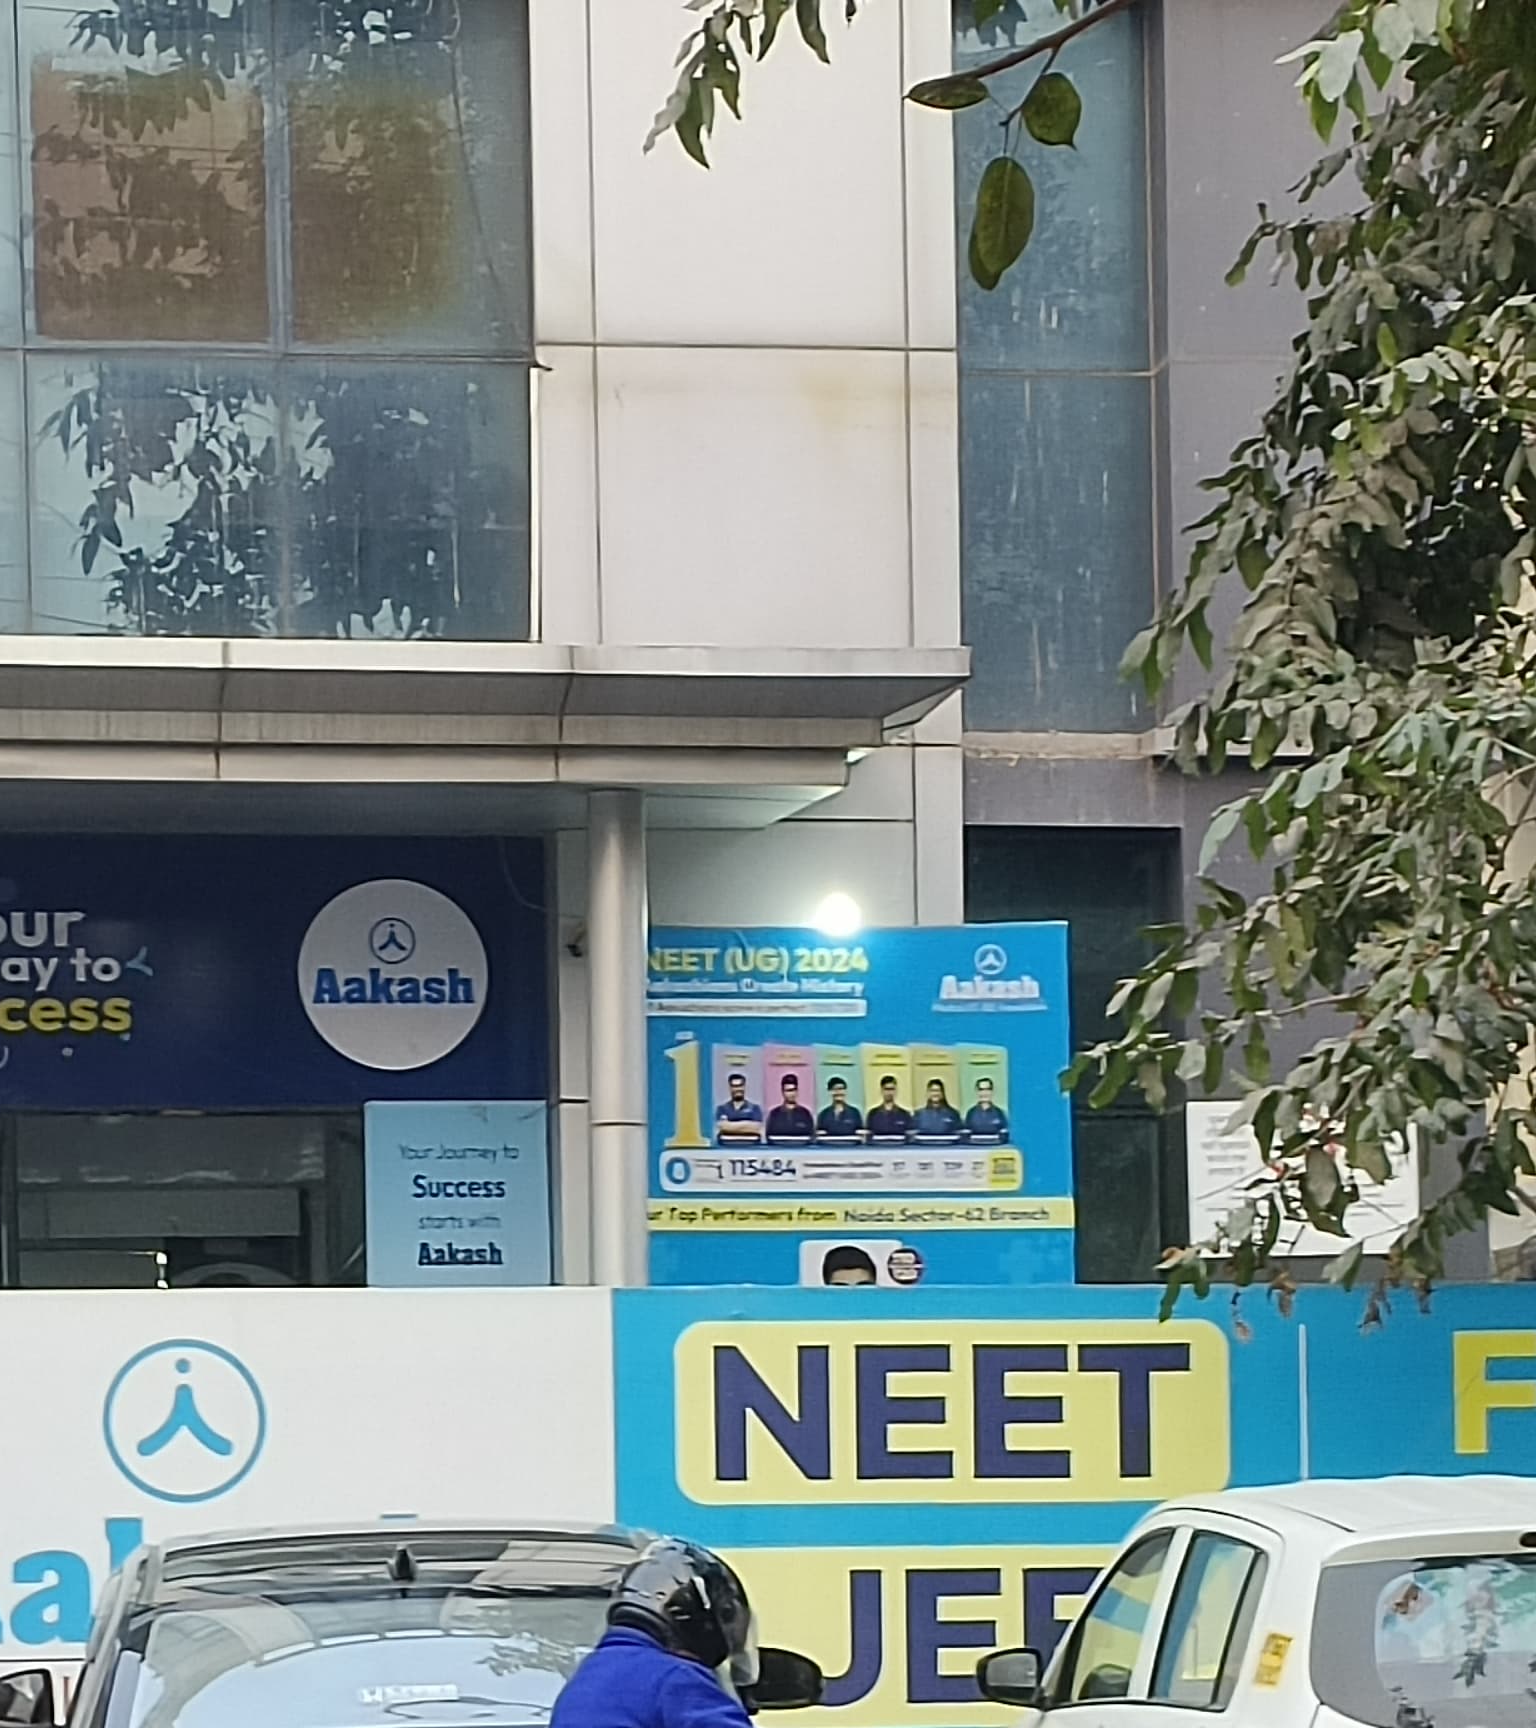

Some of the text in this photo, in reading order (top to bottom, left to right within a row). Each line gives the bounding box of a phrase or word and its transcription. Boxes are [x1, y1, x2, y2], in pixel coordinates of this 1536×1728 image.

[70, 947, 121, 982] to
[725, 946, 790, 975] (UG)
[792, 947, 869, 974] 2024
[313, 967, 475, 1004] Aakash
[412, 1174, 506, 1199] Success
[417, 1242, 503, 1266] Aakash
[713, 1343, 1192, 1481] NEET
